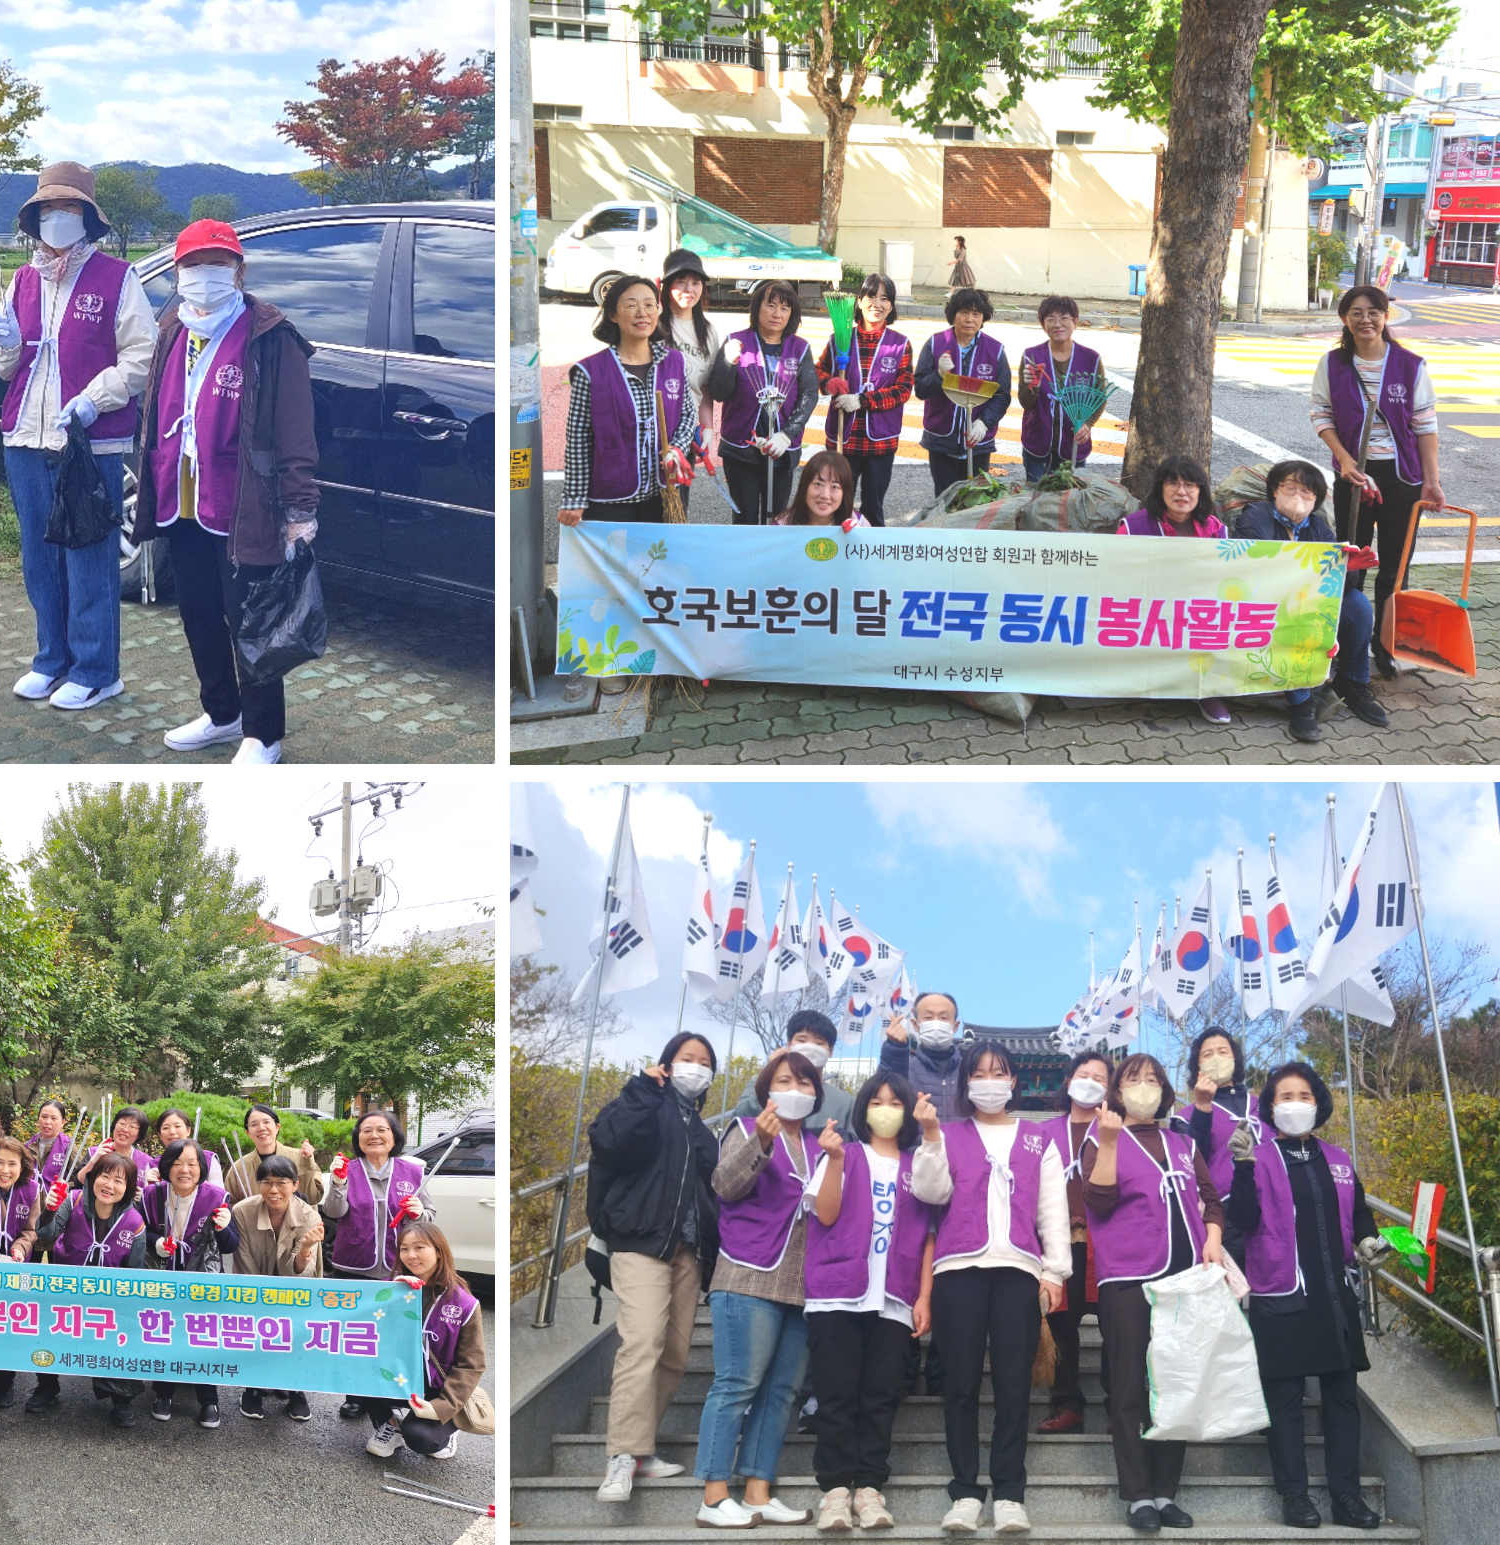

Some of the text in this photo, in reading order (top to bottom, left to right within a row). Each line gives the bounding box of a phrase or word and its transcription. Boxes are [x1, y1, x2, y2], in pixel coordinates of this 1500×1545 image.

[845, 543, 1099, 567] (사)세계평화여성연합 회원과 함께하는
[641, 586, 1280, 650] 호국보훈의 달 전국 동시 봉사활동
[893, 664, 1004, 683] 대구시 수성지부
[4, 1272, 45, 1292] 제8차
[48, 1275, 79, 1294] 전국
[81, 1277, 112, 1295] 동시
[115, 1280, 177, 1299] 봉사활동
[189, 1284, 221, 1302] 환경
[225, 1286, 257, 1304] 지킴
[261, 1288, 311, 1307] 캠페인
[50, 1303, 127, 1346] 지구,
[138, 1308, 174, 1344] 한
[184, 1312, 292, 1351] 번뿐인
[304, 1320, 380, 1357] 지금
[439, 1316, 462, 1326] WFWP
[58, 1352, 239, 1378] 세계평화여성연합 대구시지부
